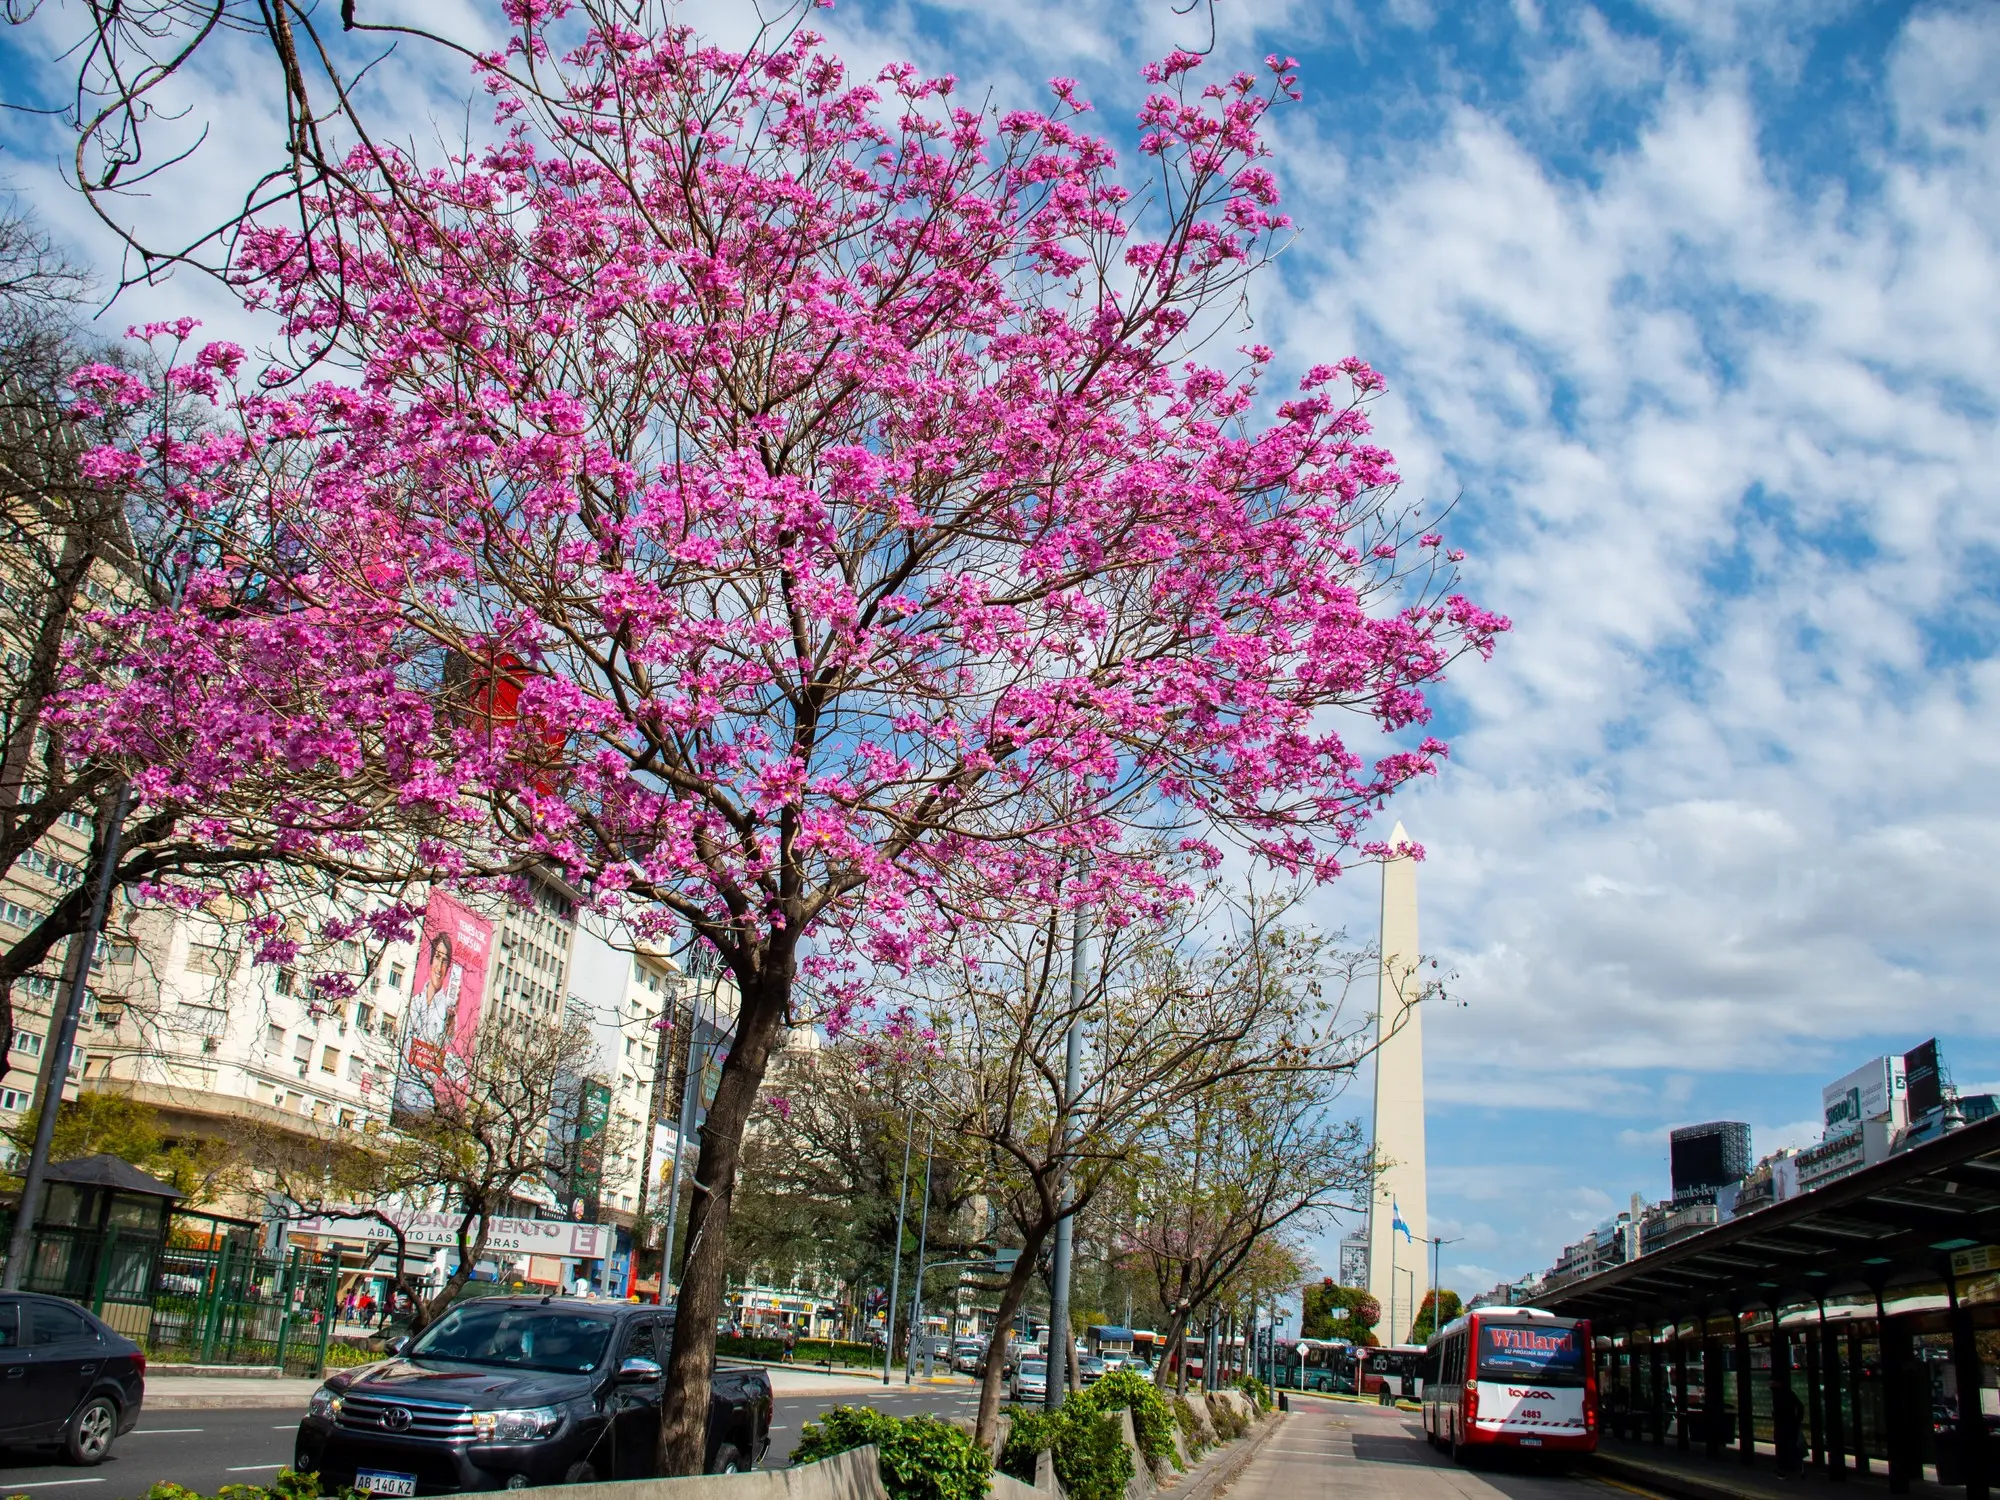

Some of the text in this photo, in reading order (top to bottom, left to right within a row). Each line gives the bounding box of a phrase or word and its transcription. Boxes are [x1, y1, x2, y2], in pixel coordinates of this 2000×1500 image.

[1826, 1099, 1848, 1127] SIGLO
[368, 1228, 520, 1248] ABIETO LAS ORAS
[1490, 1328, 1573, 1352] Willard
[1373, 1359, 1388, 1371] 100
[1521, 1409, 1542, 1419] 4883
[357, 1476, 371, 1489] AB
[374, 1478, 395, 1492] 140
[397, 1480, 412, 1494] KZ
